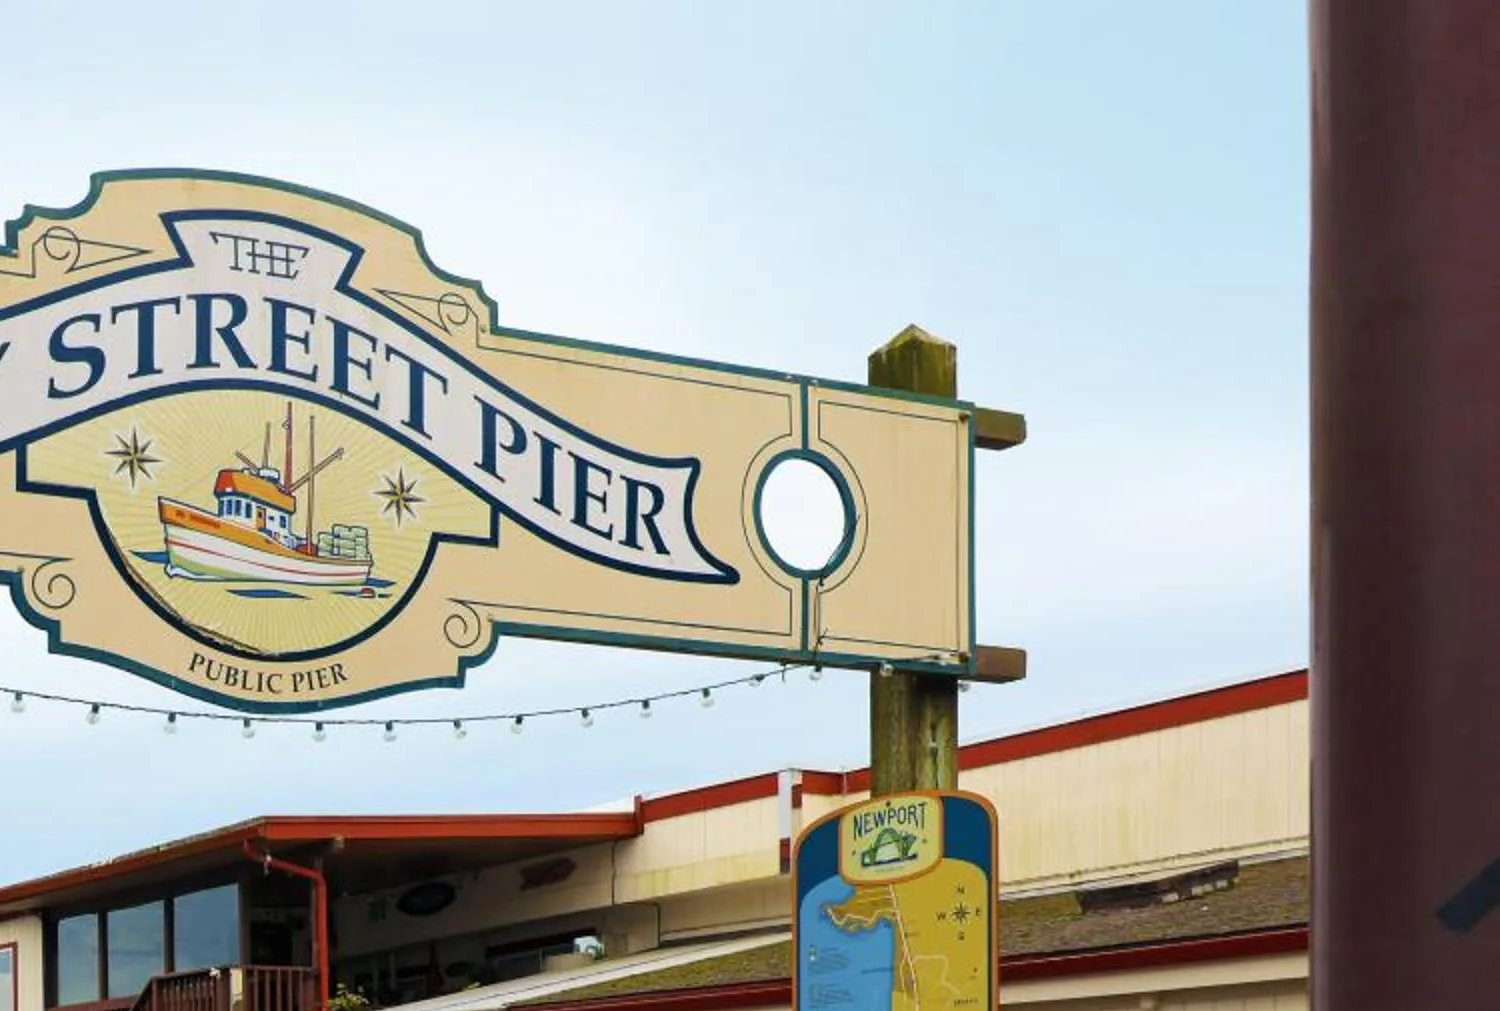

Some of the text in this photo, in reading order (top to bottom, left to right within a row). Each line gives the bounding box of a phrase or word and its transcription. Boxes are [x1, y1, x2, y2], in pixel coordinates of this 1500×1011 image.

[208, 230, 310, 279] THE
[46, 292, 448, 440] STREET
[473, 394, 670, 556] PIER
[187, 651, 348, 695] PUBLIC PIER
[852, 802, 928, 840] NEWPORT
